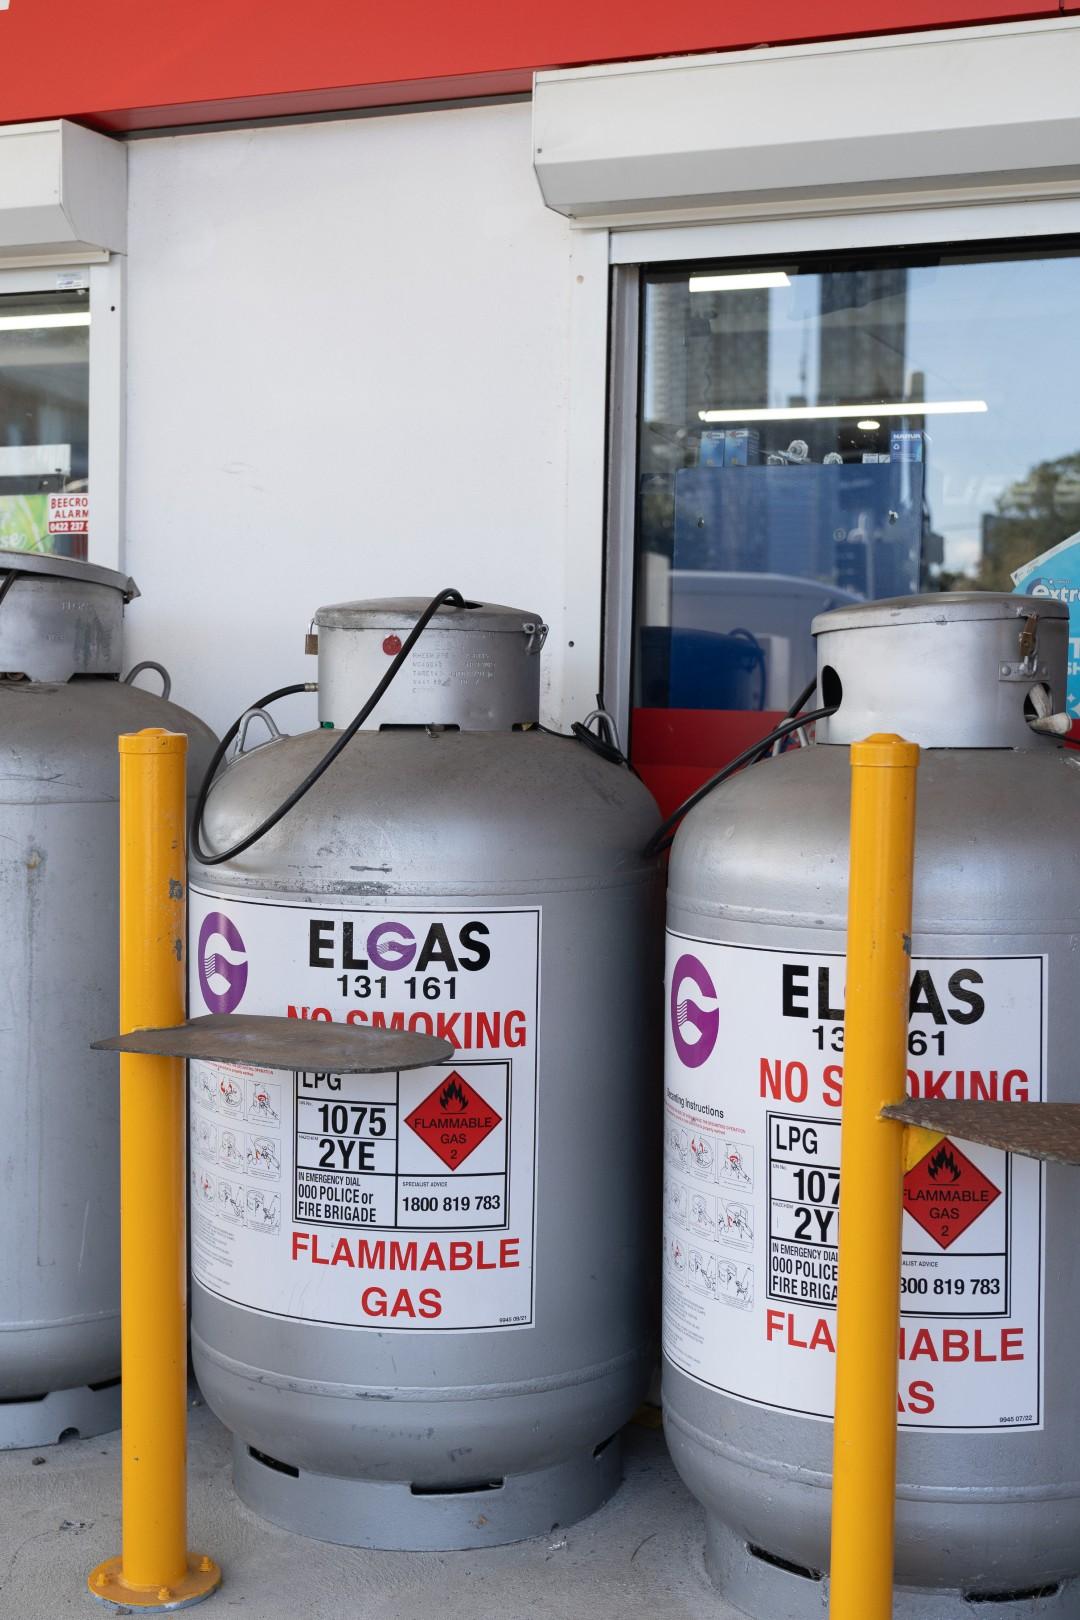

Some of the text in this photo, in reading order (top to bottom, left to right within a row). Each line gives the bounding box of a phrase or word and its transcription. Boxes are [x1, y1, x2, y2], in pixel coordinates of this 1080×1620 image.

[51, 498, 88, 509] BEECRO
[309, 919, 491, 972] ELGAS
[337, 974, 456, 1000] 131 161
[782, 963, 985, 1026] ELAS
[760, 1057, 809, 1103] NO
[318, 1103, 387, 1137] 1075
[414, 1117, 492, 1129] FLAMMABLE
[440, 1133, 467, 1144] GAS
[776, 1123, 818, 1154] LPG
[318, 1138, 376, 1171] 2YE
[450, 1149, 457, 1160] 2
[298, 1172, 361, 1187] IN EMERGENCY DIAL
[793, 1168, 841, 1205] 107
[298, 1184, 374, 1204] 000 POLICE or
[402, 1195, 501, 1212] 1800 819 783
[298, 1201, 322, 1218] FIRE
[325, 1203, 377, 1222] BRIGADE
[929, 1207, 960, 1219] GAS
[795, 1207, 839, 1243] 2Y
[941, 1225, 949, 1237] 2
[291, 1231, 520, 1272] FLAMMABLE
[773, 1242, 779, 1253] IN
[780, 1244, 822, 1261] EMERGENCY
[773, 1256, 838, 1281] 000 POLICE
[772, 1275, 798, 1296] FIRE
[801, 1280, 838, 1301] BRIGA
[933, 1278, 965, 1295] 819
[970, 1278, 1001, 1295] 783
[361, 1286, 443, 1319] GAS
[766, 1308, 1025, 1363] FLAABLE
